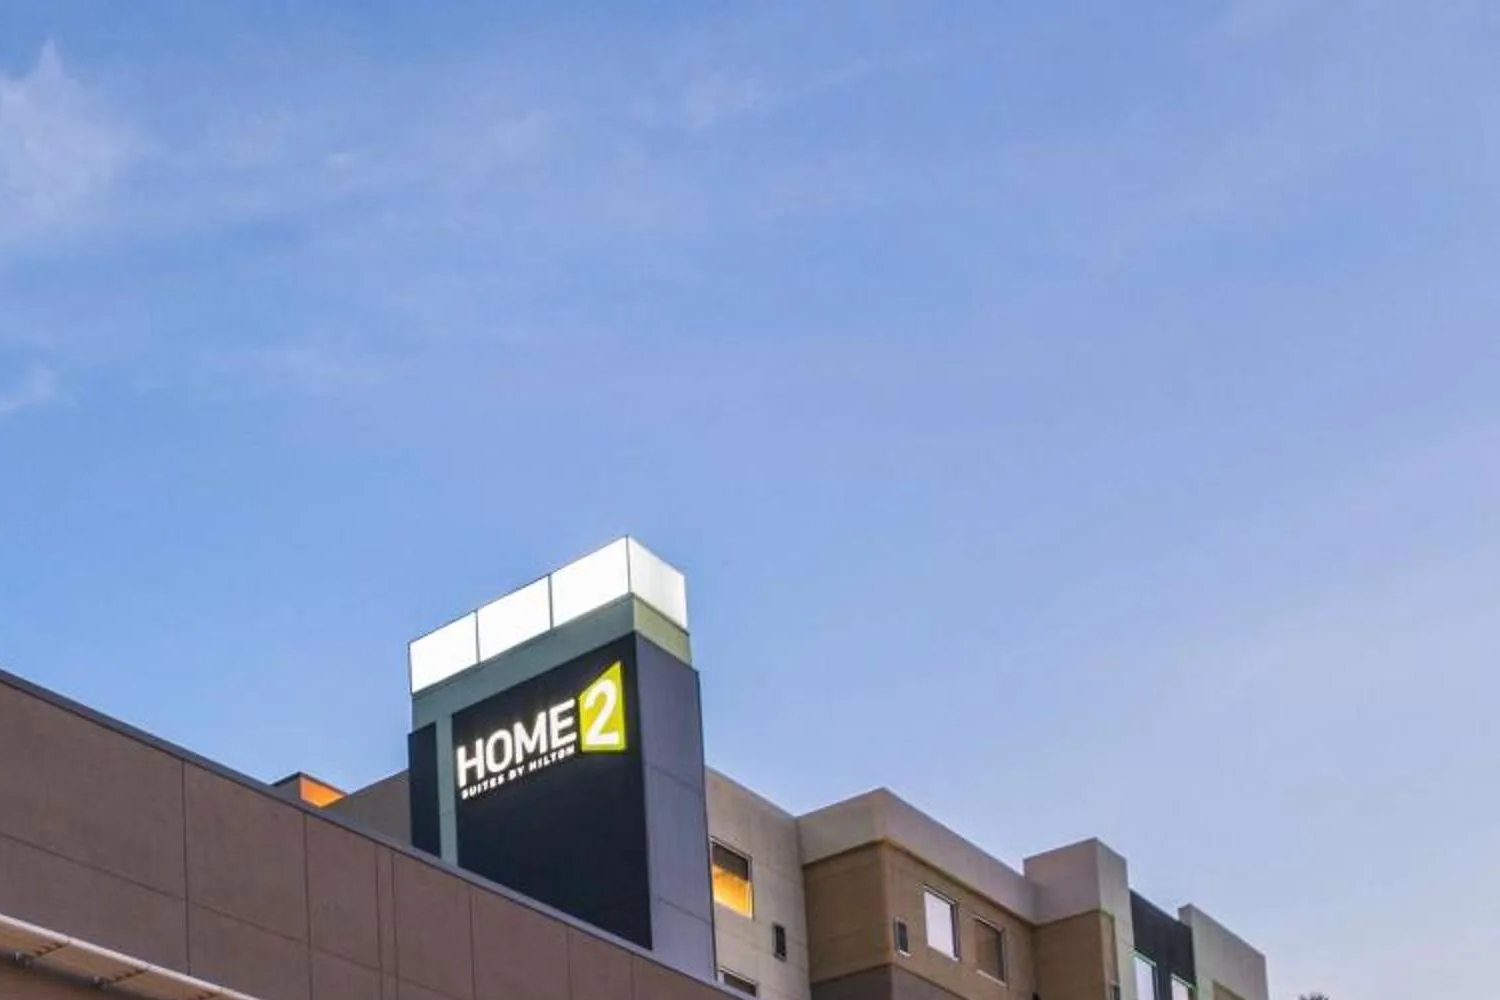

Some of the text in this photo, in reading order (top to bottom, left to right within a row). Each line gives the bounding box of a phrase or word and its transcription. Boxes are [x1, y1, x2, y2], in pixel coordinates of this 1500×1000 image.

[456, 698, 578, 788] HOME
[461, 744, 576, 800] SUITES BY HILTON
